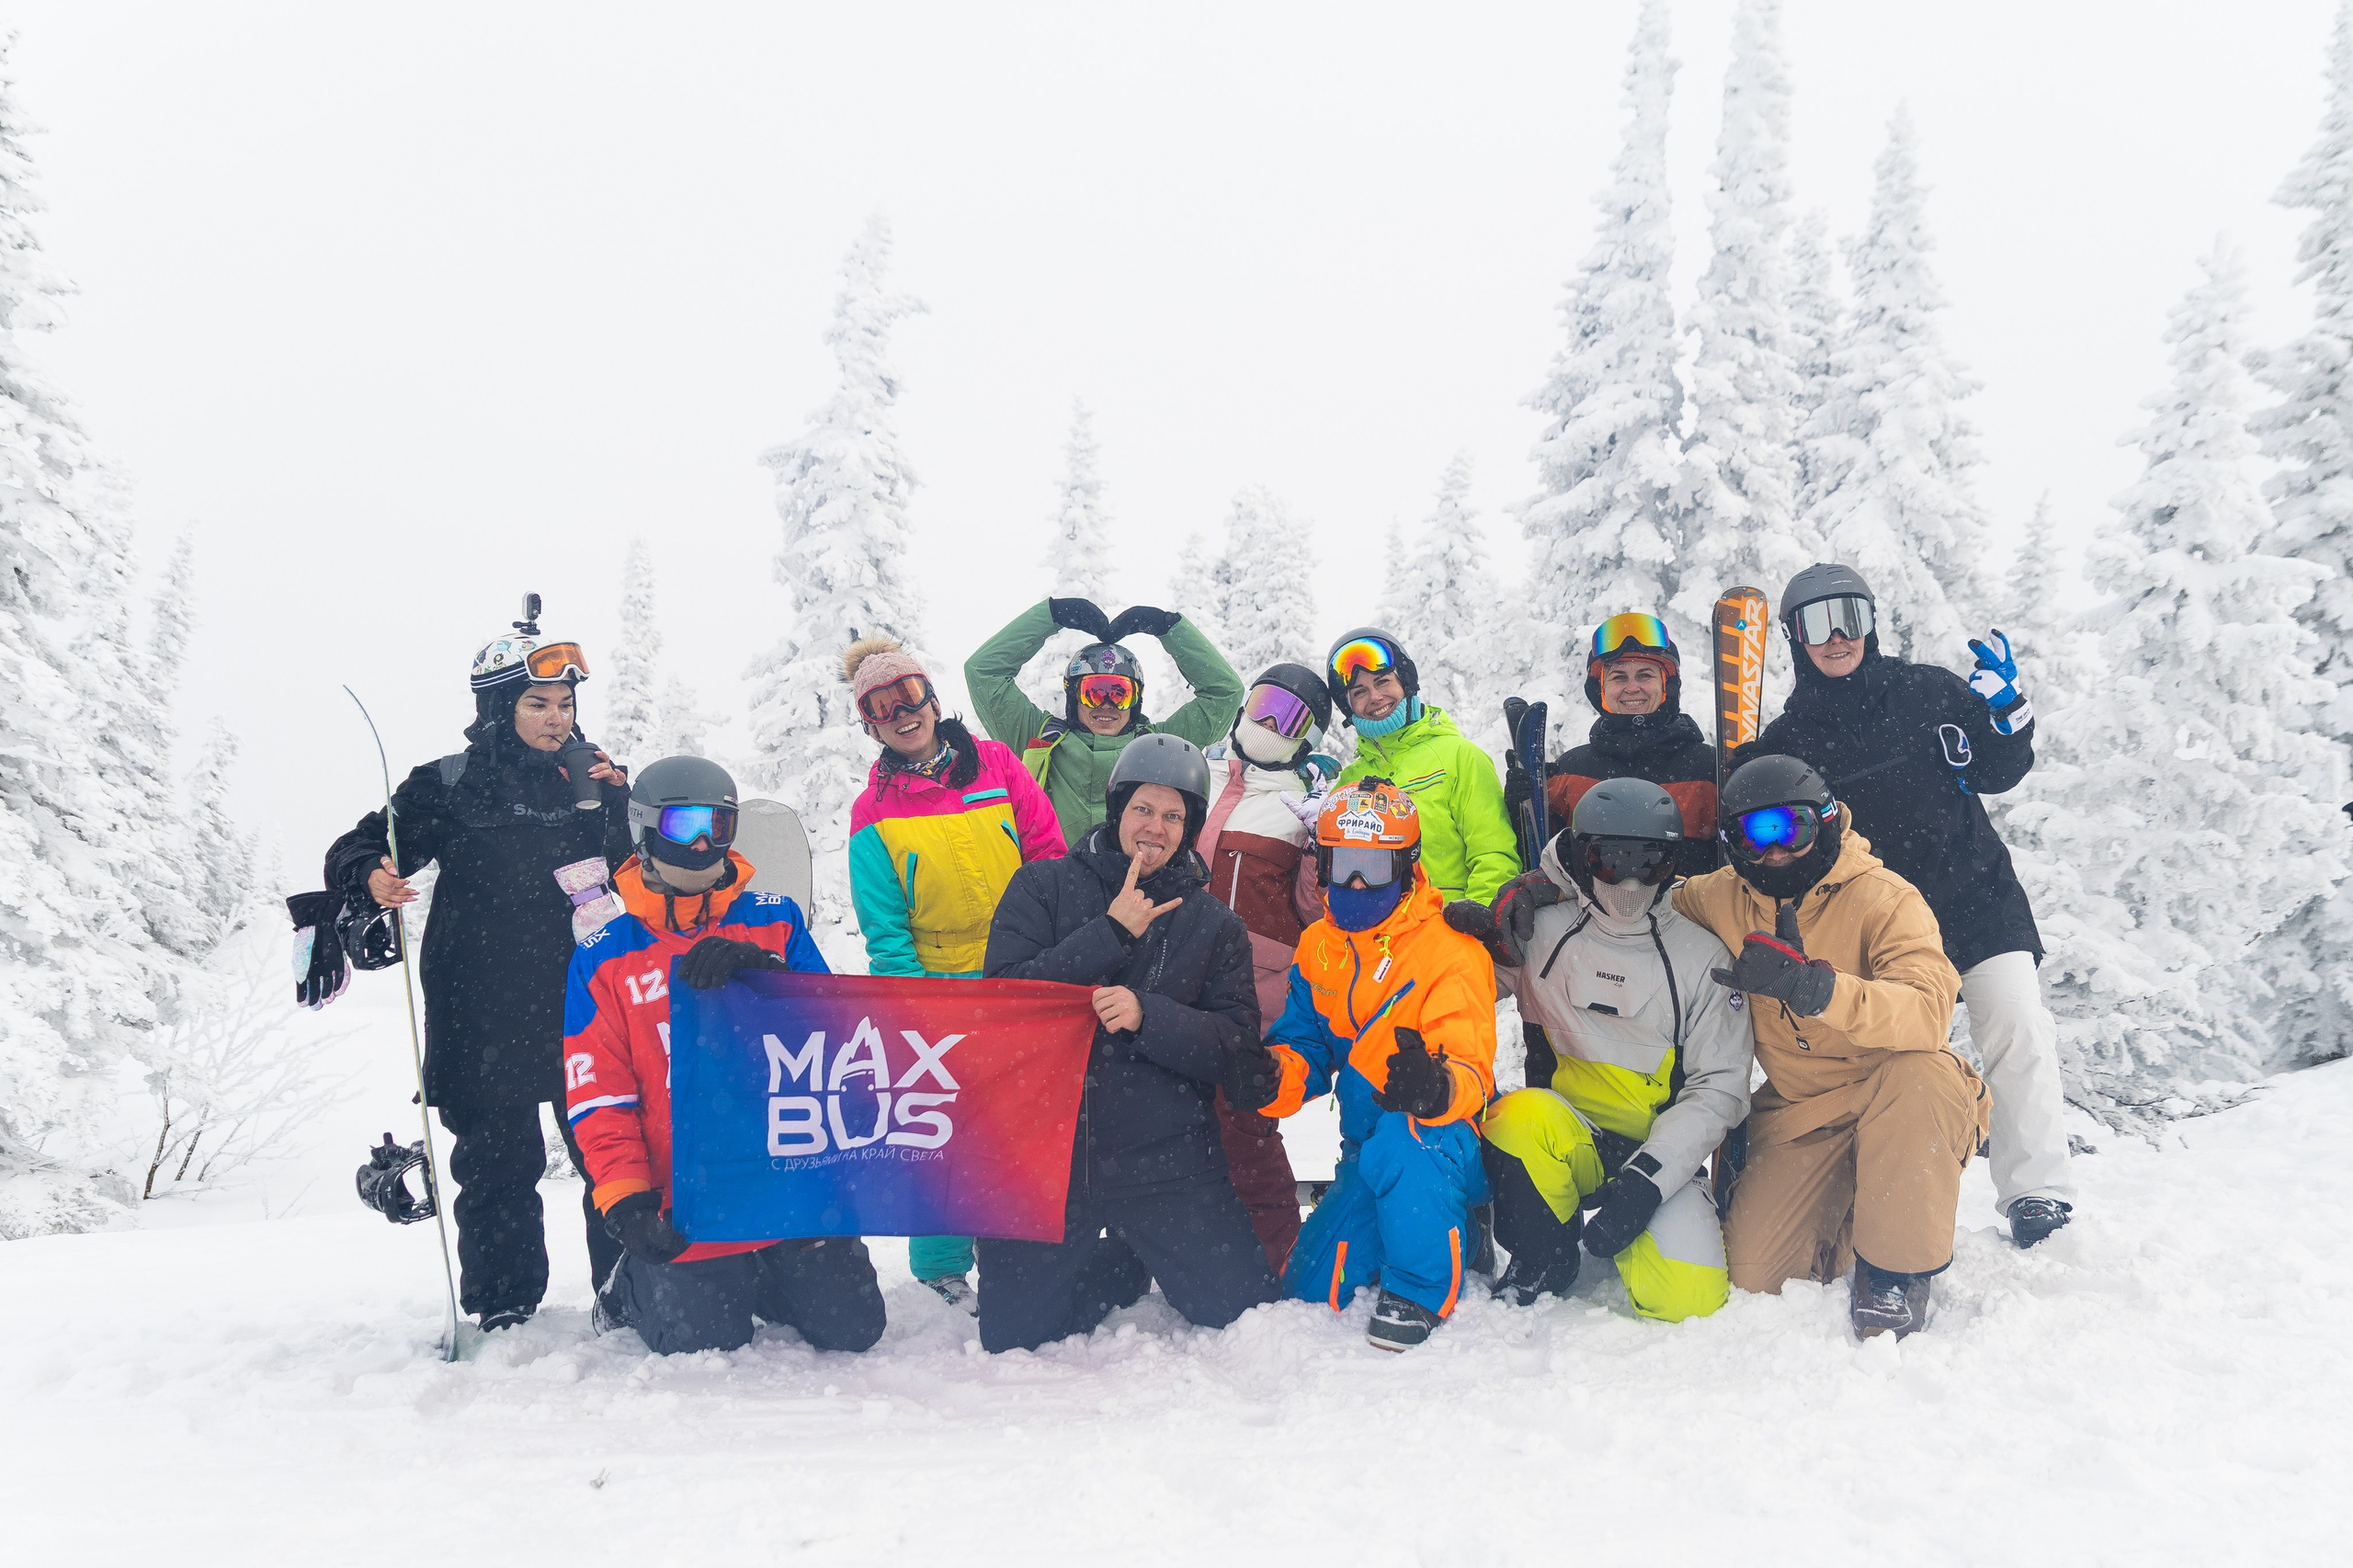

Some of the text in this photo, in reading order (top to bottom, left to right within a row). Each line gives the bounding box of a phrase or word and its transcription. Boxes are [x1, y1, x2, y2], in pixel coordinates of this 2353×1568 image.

[1742, 598, 1764, 744] YNASTAR
[624, 967, 669, 1006] 12
[1596, 971, 1626, 983] HASKER
[565, 1051, 597, 1092] 12
[762, 1016, 968, 1093] MAX
[767, 1091, 959, 1157] BUS
[771, 1145, 944, 1172] С ДРУЗЬЯМИ НА КРАЙ СВЕТА
